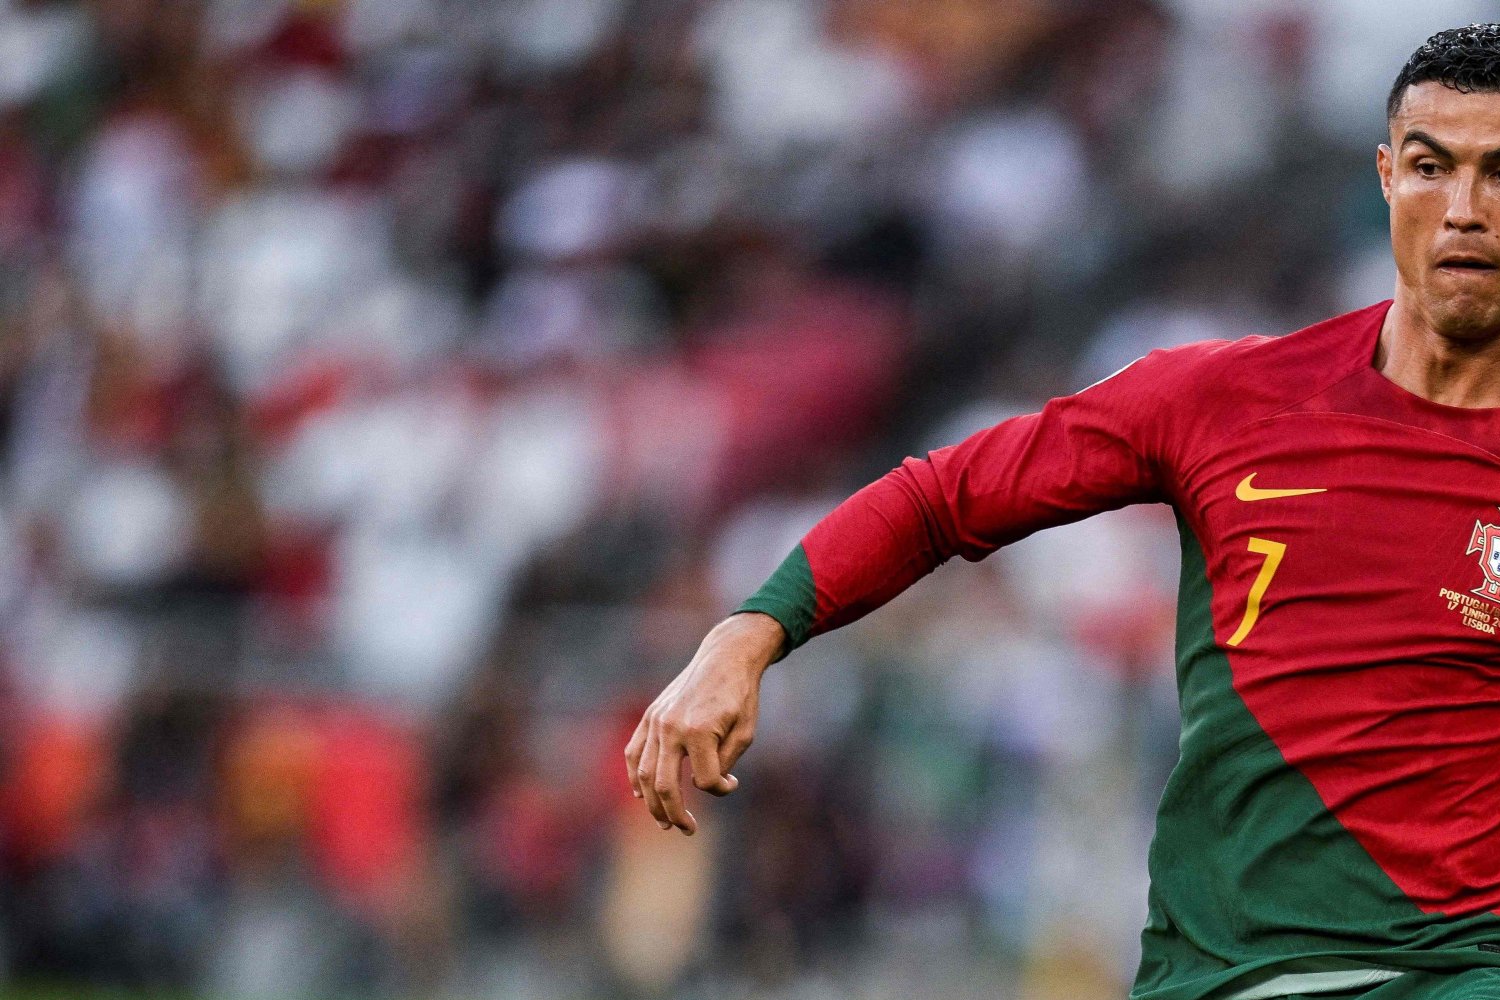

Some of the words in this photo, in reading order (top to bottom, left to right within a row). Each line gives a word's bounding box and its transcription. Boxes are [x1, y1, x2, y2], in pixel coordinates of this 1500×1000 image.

[1226, 537, 1287, 647] 7
[1447, 600, 1460, 611] 17
[1460, 605, 1491, 623] JUNHO
[1462, 615, 1496, 635] LISBOA
